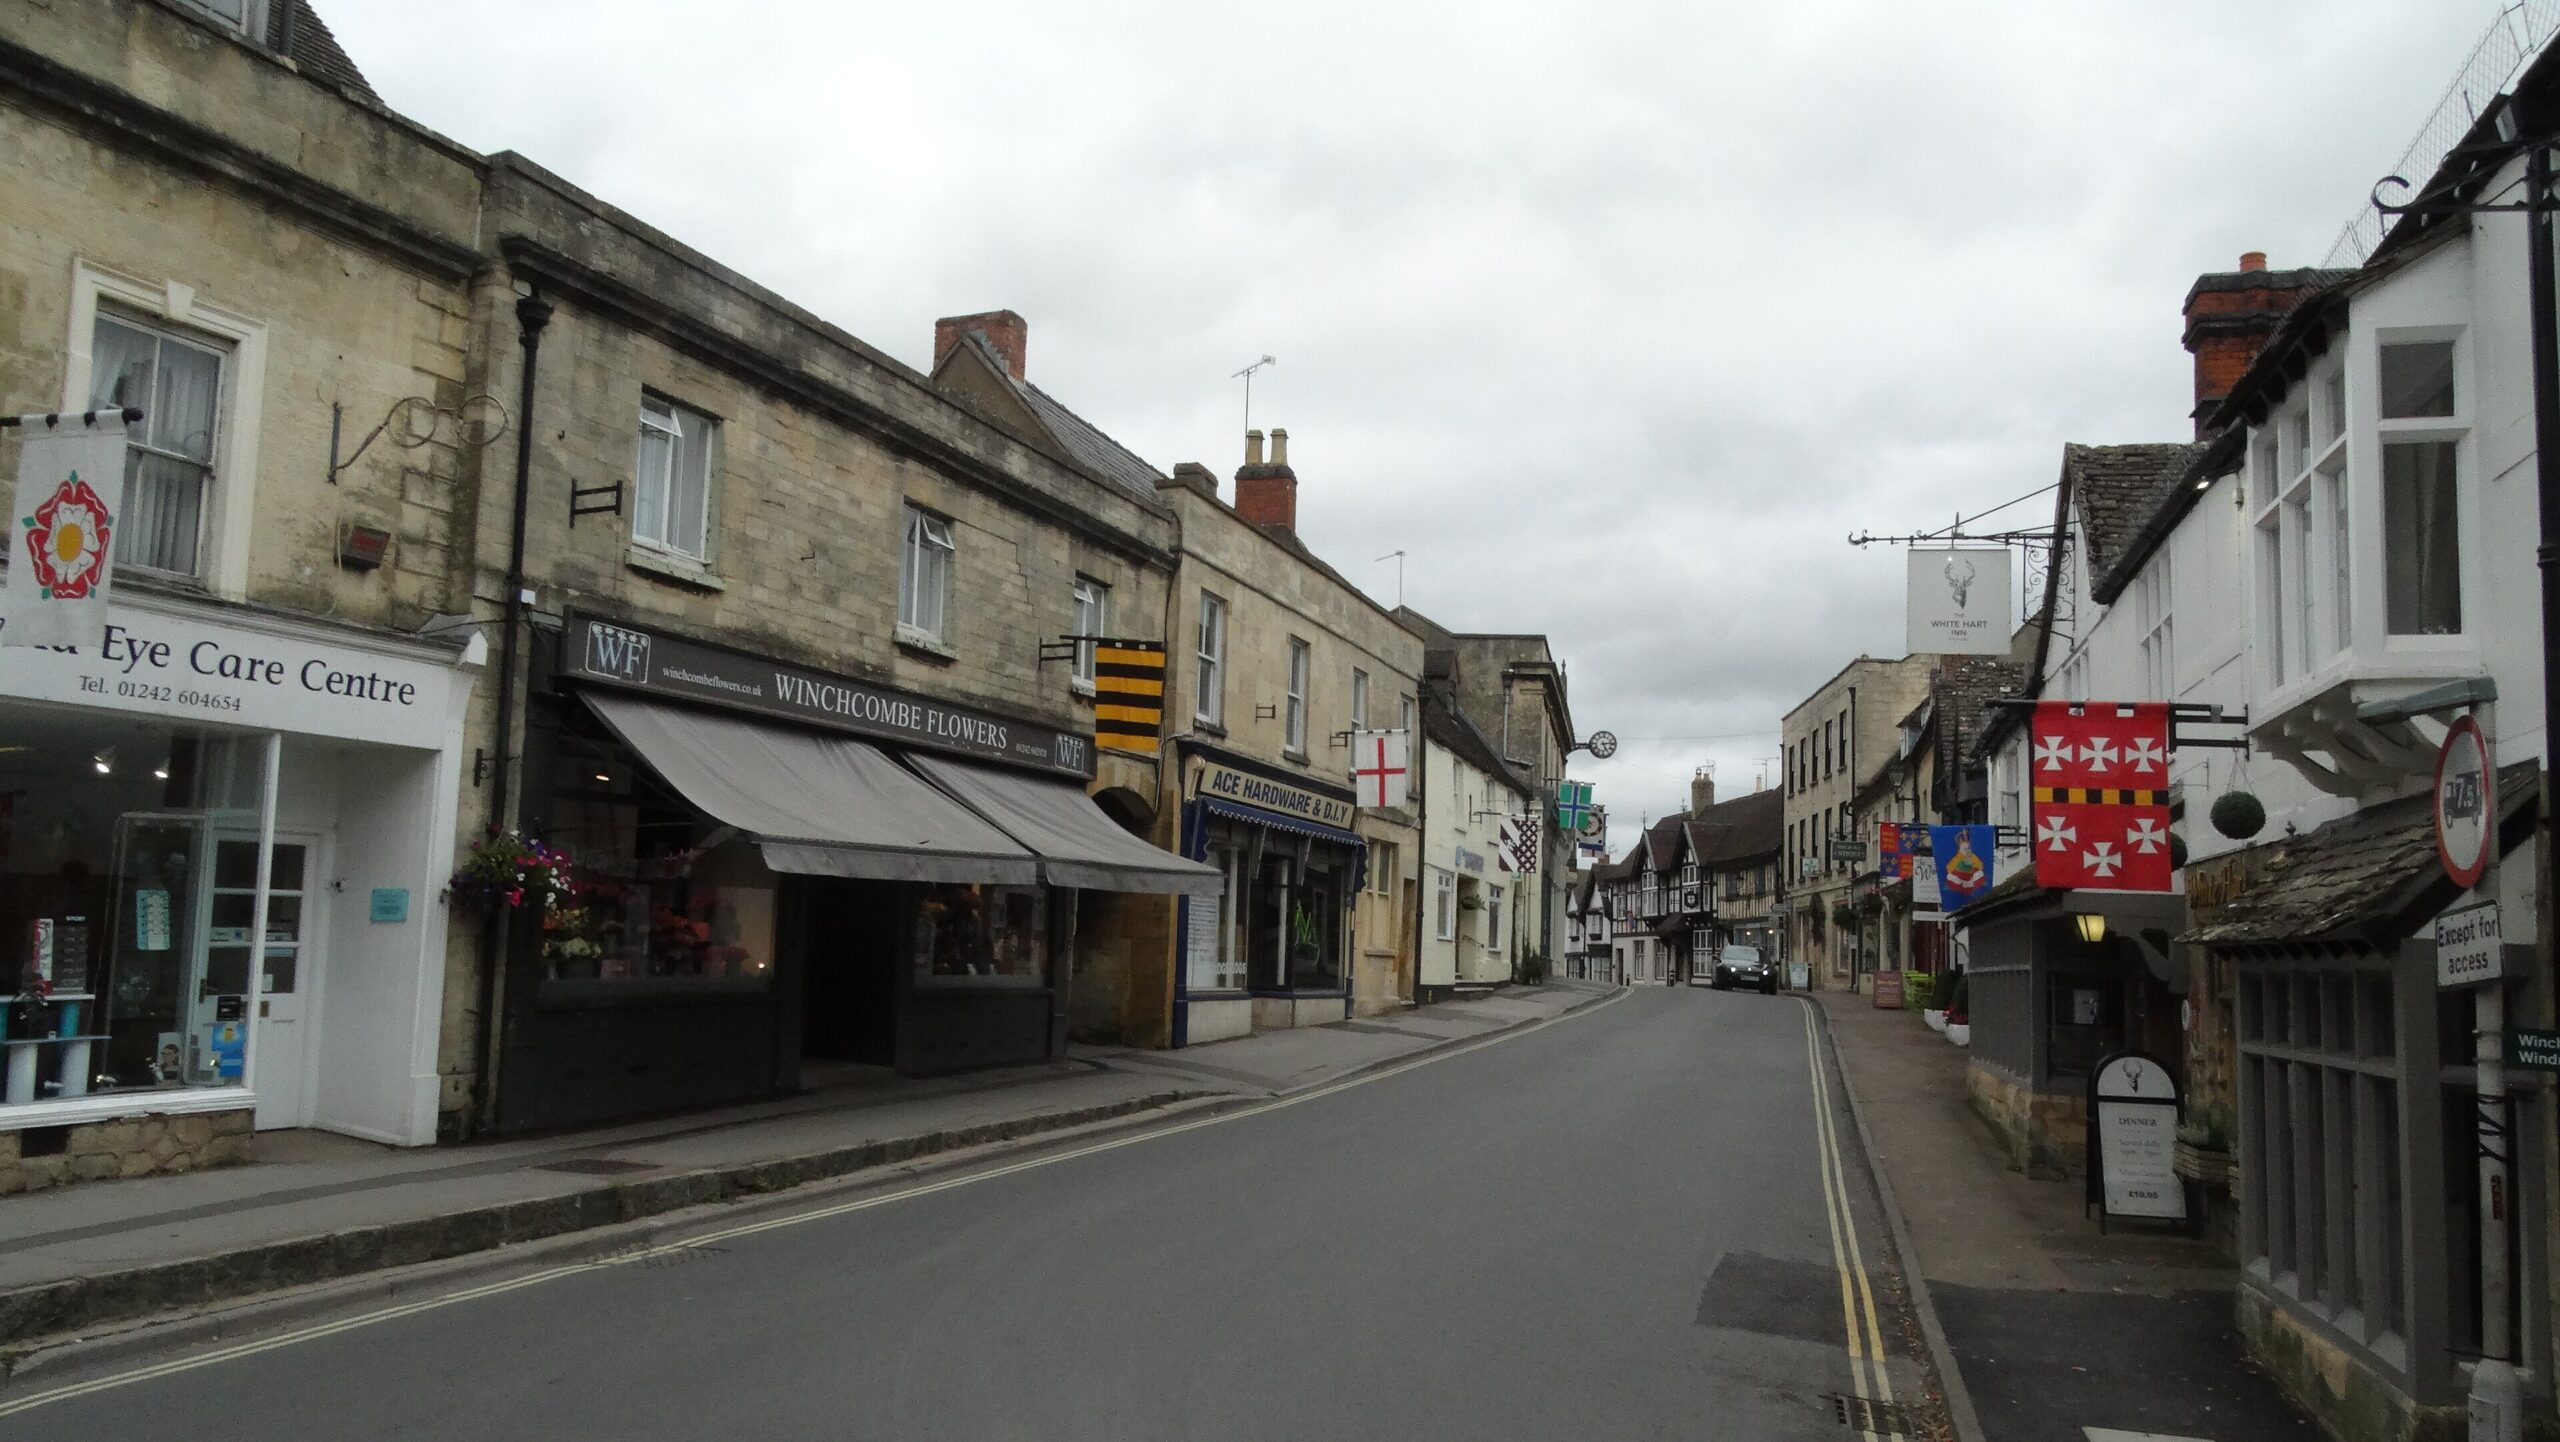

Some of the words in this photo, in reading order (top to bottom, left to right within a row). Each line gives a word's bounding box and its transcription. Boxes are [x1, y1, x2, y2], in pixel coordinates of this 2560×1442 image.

[1931, 620, 1960, 629] WHITE
[1962, 620, 1988, 629] HART
[1951, 629, 1967, 637] INN
[101, 624, 172, 674] Eye
[190, 641, 285, 686] Care
[300, 659, 417, 706] Centre
[79, 675, 110, 695] Tel.
[118, 681, 172, 702] 01242
[178, 688, 242, 712] 604654
[662, 666, 763, 697] winchcombeflowers.co.uk
[774, 673, 922, 730] WINCHCOMBE
[926, 709, 1008, 749] FLOWERS
[1212, 770, 1241, 795] ACE
[1243, 779, 1311, 812] HARDWARE
[1312, 799, 1322, 817] &
[2438, 919, 2476, 948] Except
[2478, 915, 2496, 938] for
[2448, 951, 2488, 975] access
[2118, 1117, 2158, 1127] DINNER
